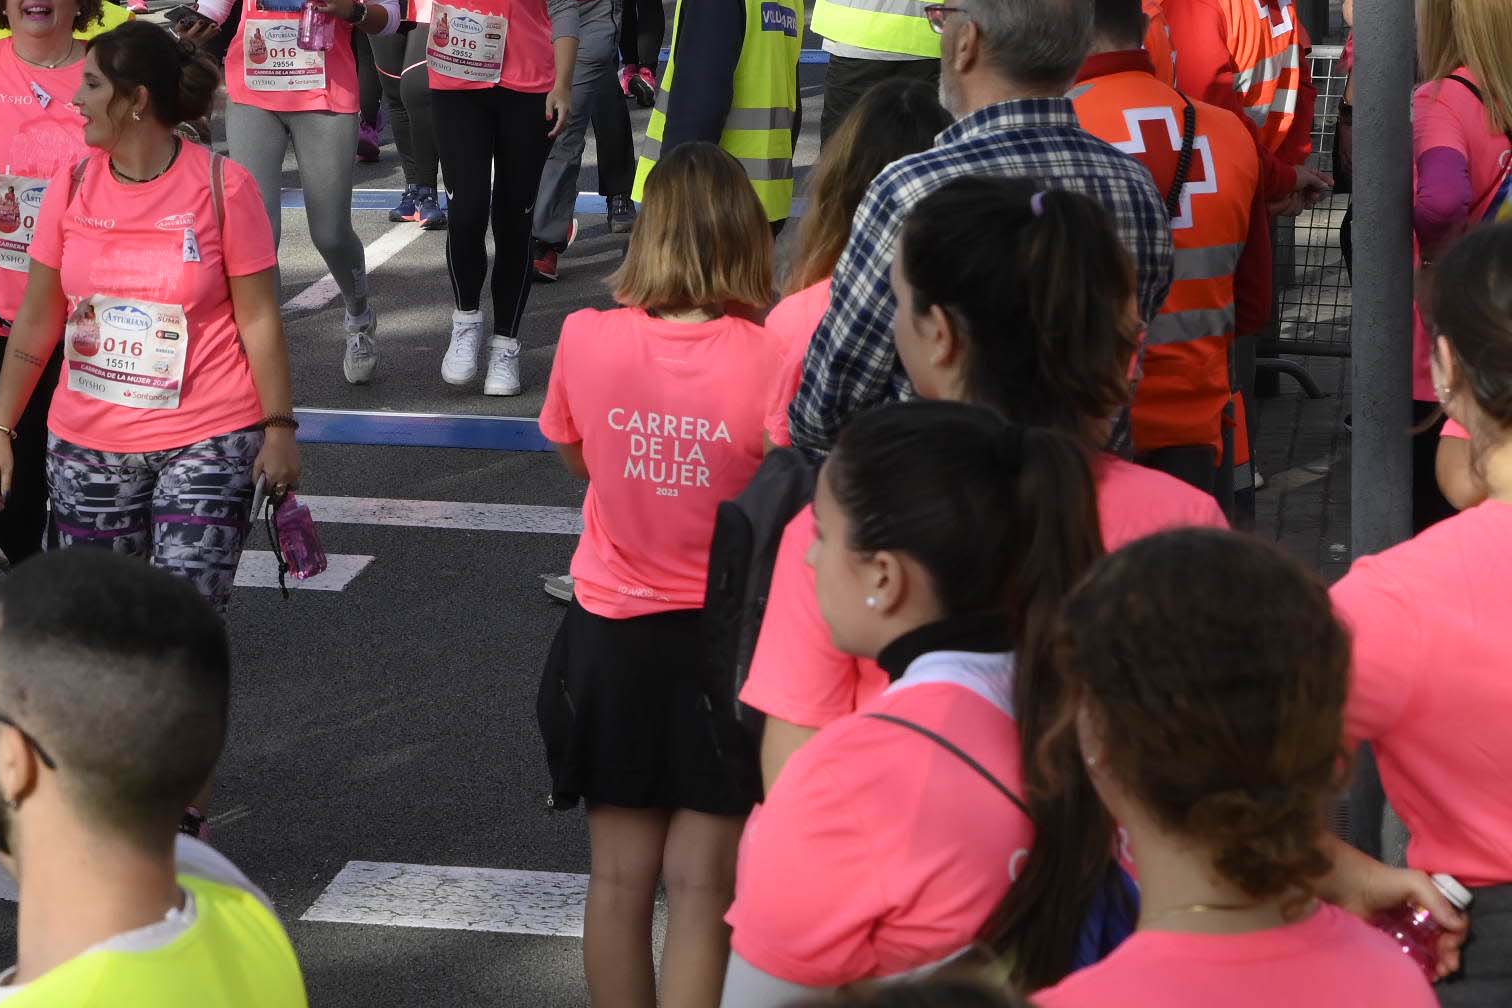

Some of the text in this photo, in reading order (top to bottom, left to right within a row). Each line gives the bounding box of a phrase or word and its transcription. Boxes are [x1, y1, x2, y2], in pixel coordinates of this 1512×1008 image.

[451, 36, 477, 50] 016
[270, 48, 297, 58] 016
[452, 48, 473, 58] 29552
[105, 313, 150, 327] ASTURIANA
[157, 316, 180, 325] SUMA
[103, 338, 143, 357] 016
[106, 358, 135, 370] 15511
[80, 364, 106, 377] CARRERA
[127, 376, 151, 385] MUJER
[79, 376, 170, 402] OYSHO Santander
[608, 407, 732, 443] CARRERA
[630, 435, 705, 464] DE LA
[623, 456, 710, 487] MUJER
